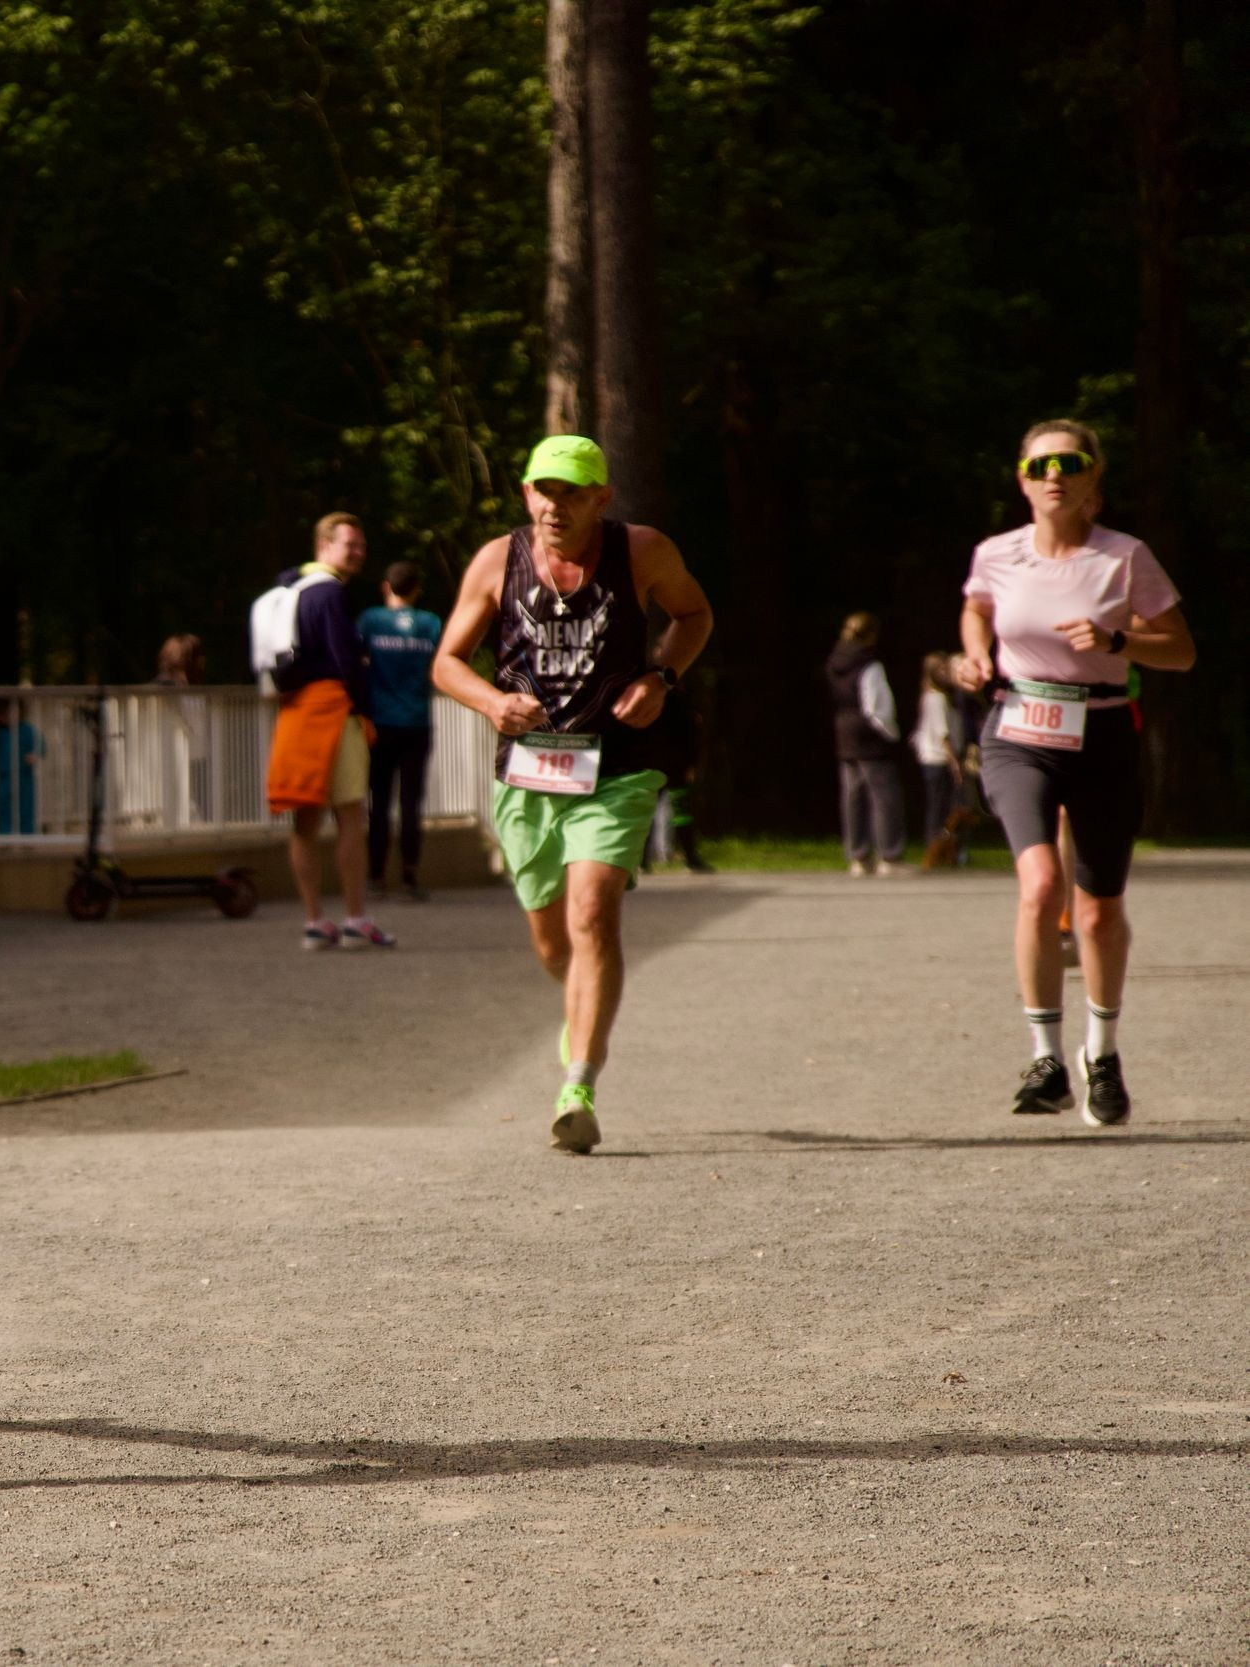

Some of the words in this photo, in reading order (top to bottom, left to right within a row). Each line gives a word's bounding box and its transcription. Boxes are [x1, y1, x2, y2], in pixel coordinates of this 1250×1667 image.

[536, 618, 595, 649] NENA
[1022, 702, 1064, 730] 108
[537, 753, 575, 776] 119
